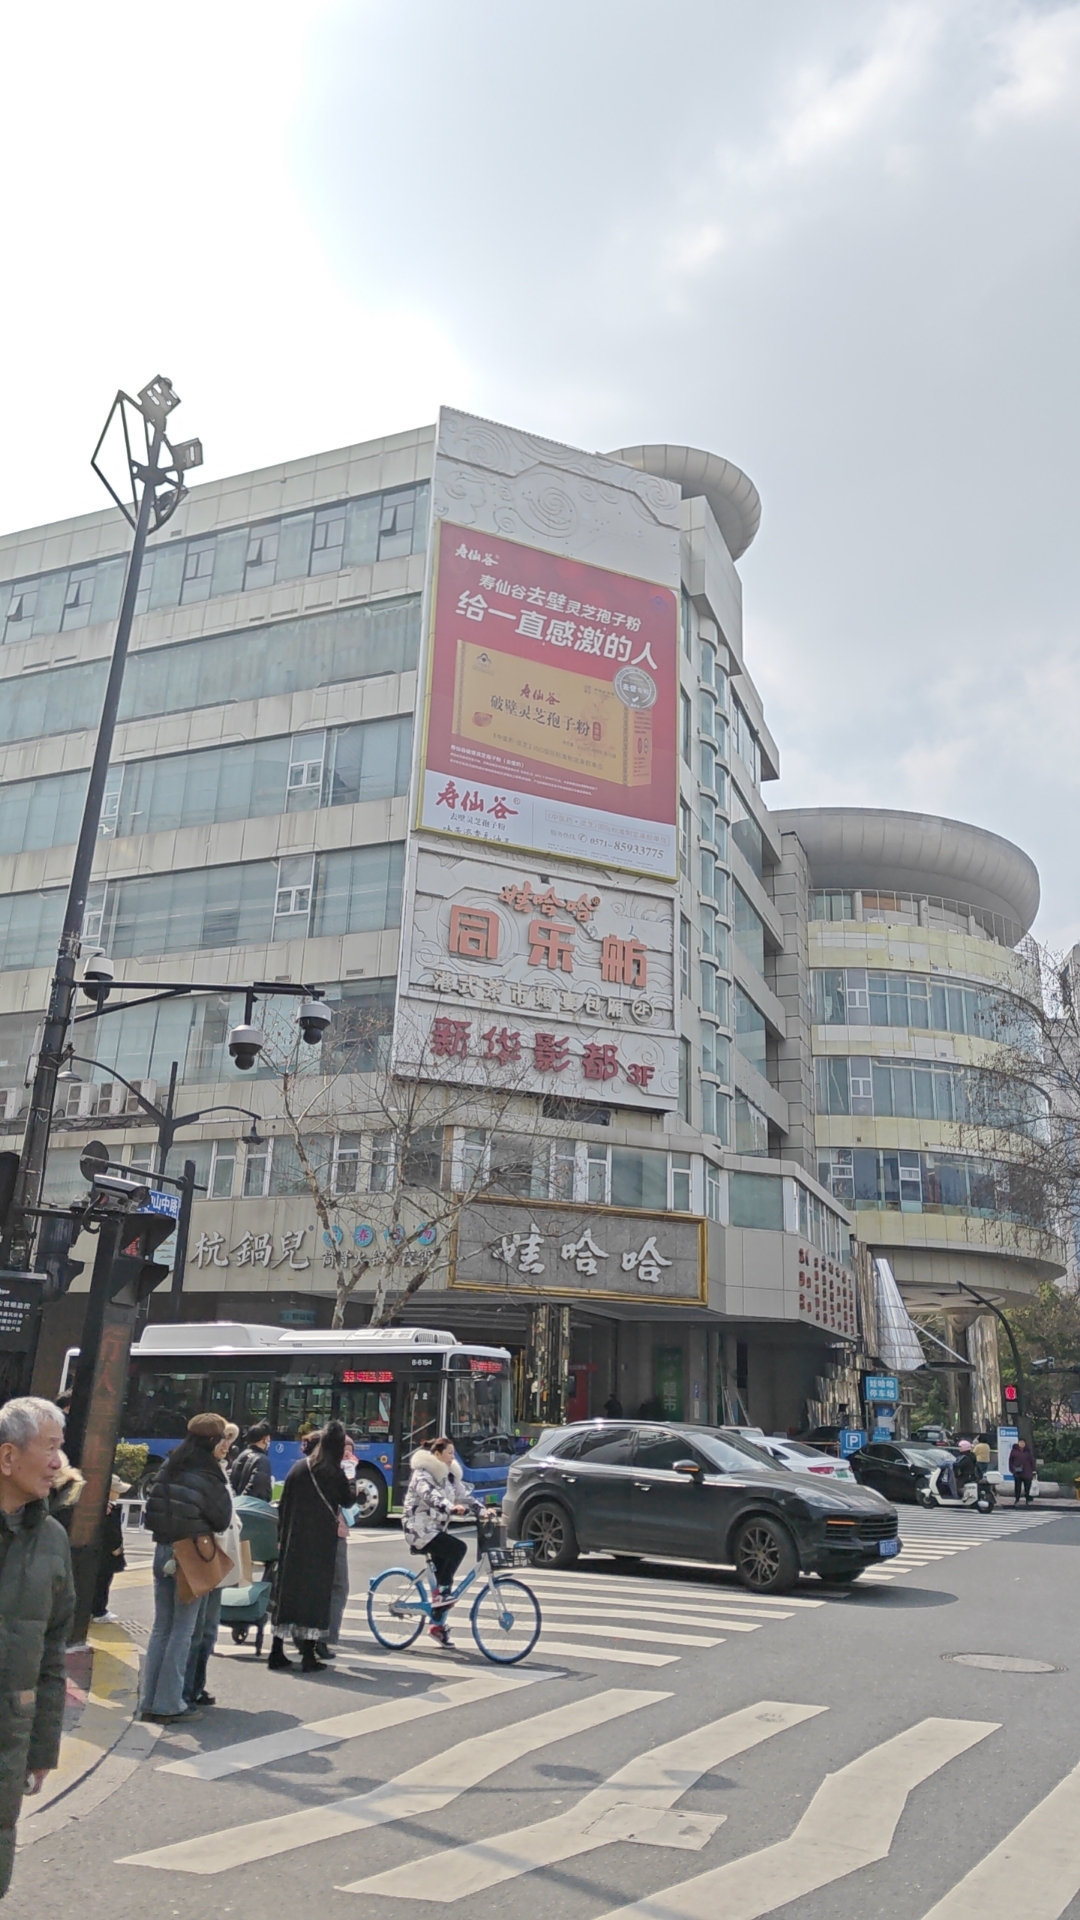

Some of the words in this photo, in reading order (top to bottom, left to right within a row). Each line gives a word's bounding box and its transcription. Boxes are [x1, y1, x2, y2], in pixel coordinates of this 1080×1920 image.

[455, 544, 498, 566] 寿仙谷
[479, 574, 641, 632] 寿仙谷去壁灵芝孢子粉
[455, 590, 658, 669] 给一直感激的人
[520, 683, 560, 705] 寿仙谷
[490, 695, 590, 737] 破壁灵芝孢子粉
[435, 780, 519, 820] 寿仙谷
[590, 837, 665, 860] 0571-85933775
[498, 881, 597, 922] 娃哈哈
[449, 904, 648, 988] 同乐舫
[430, 1016, 619, 1081] 新华影都
[627, 1063, 655, 1087] 3F
[493, 1223, 672, 1282] 娃哈哈
[869, 1380, 894, 1389] 娃哈哈
[870, 1389, 895, 1398] 停车场
